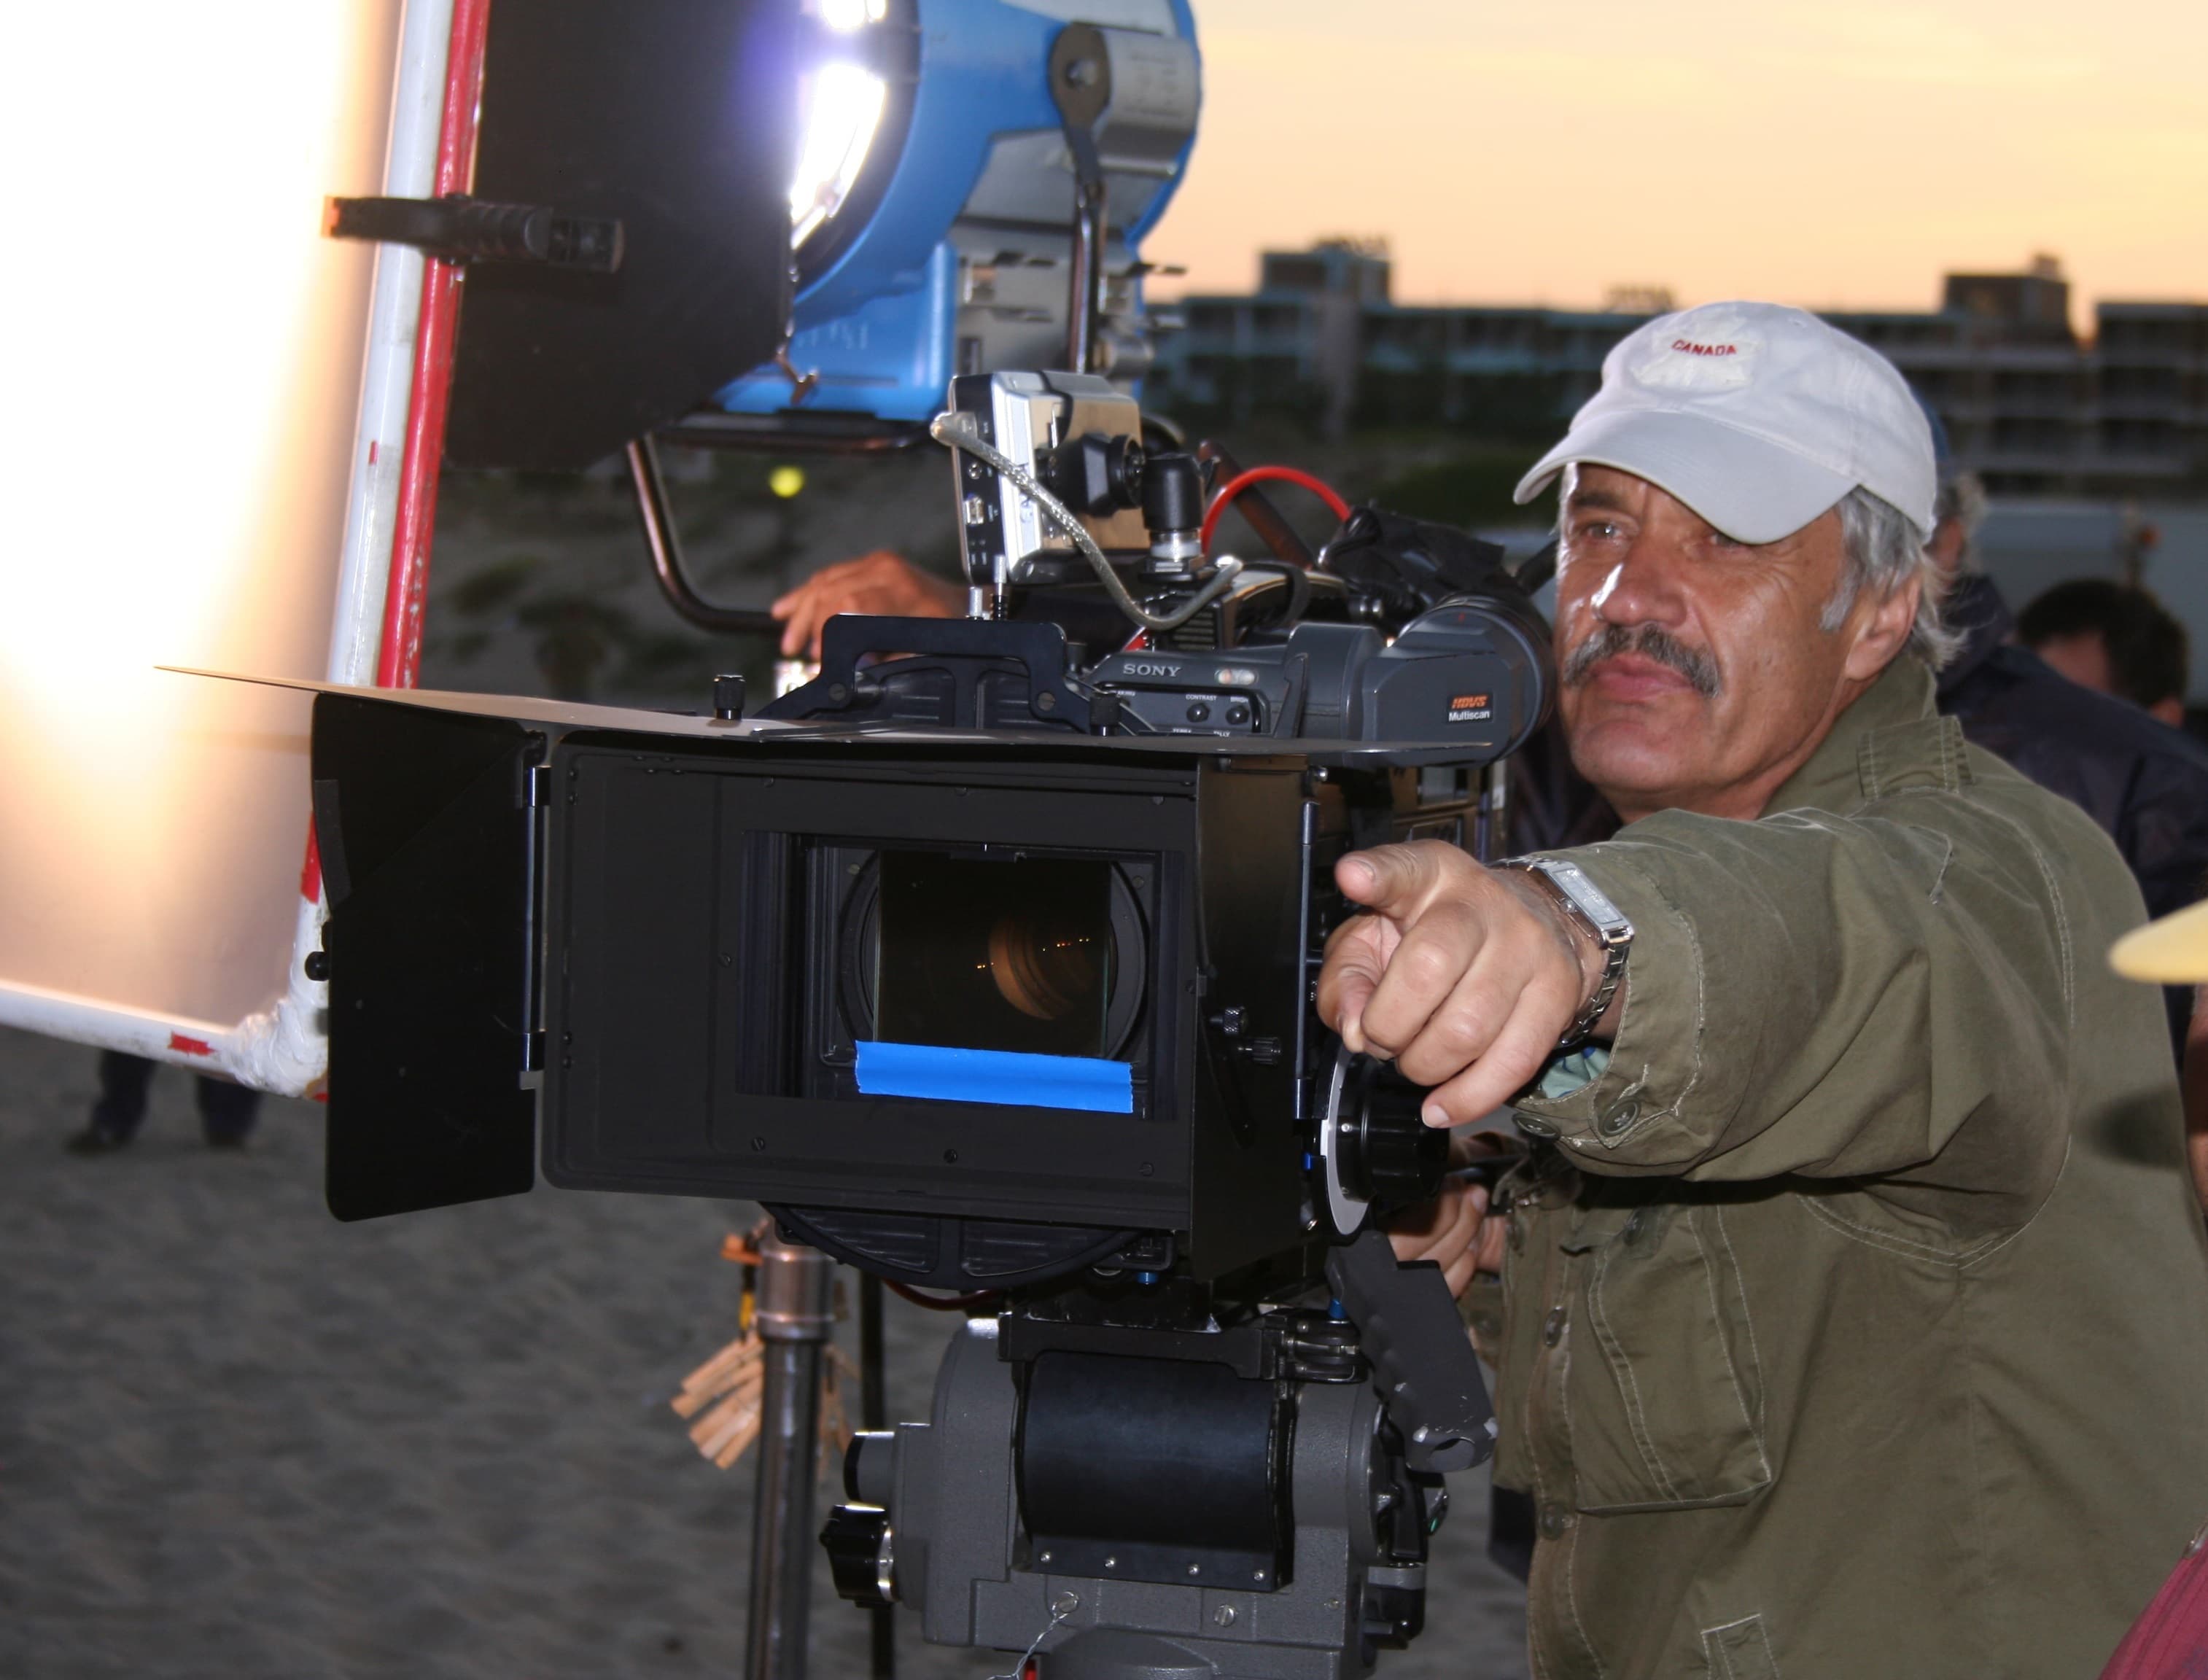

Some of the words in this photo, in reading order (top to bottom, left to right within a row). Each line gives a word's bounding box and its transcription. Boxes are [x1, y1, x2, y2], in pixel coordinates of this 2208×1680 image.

[1671, 339, 1737, 356] CANADA
[1123, 664, 1181, 677] SONY
[1448, 710, 1490, 721] Multiscan
